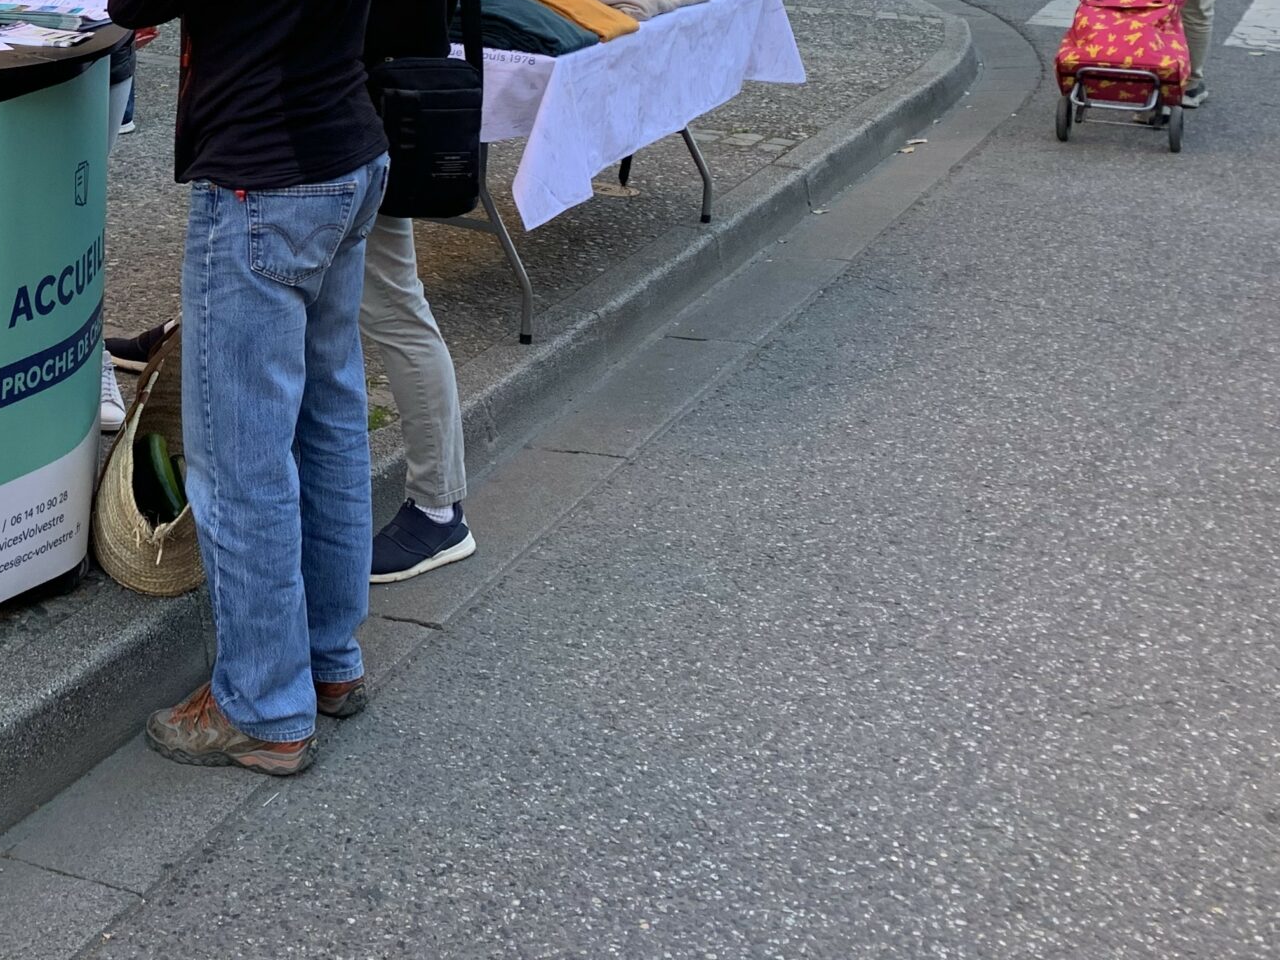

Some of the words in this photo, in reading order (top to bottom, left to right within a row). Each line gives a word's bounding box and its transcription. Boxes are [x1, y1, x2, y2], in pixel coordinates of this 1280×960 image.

[510, 54, 536, 66] 1978
[1, 347, 75, 401] PROCHE
[77, 333, 90, 363] DE
[10, 512, 22, 527] 06
[25, 507, 34, 521] 14
[36, 502, 45, 516] 10
[46, 496, 58, 511] 90
[59, 490, 68, 504] 28
